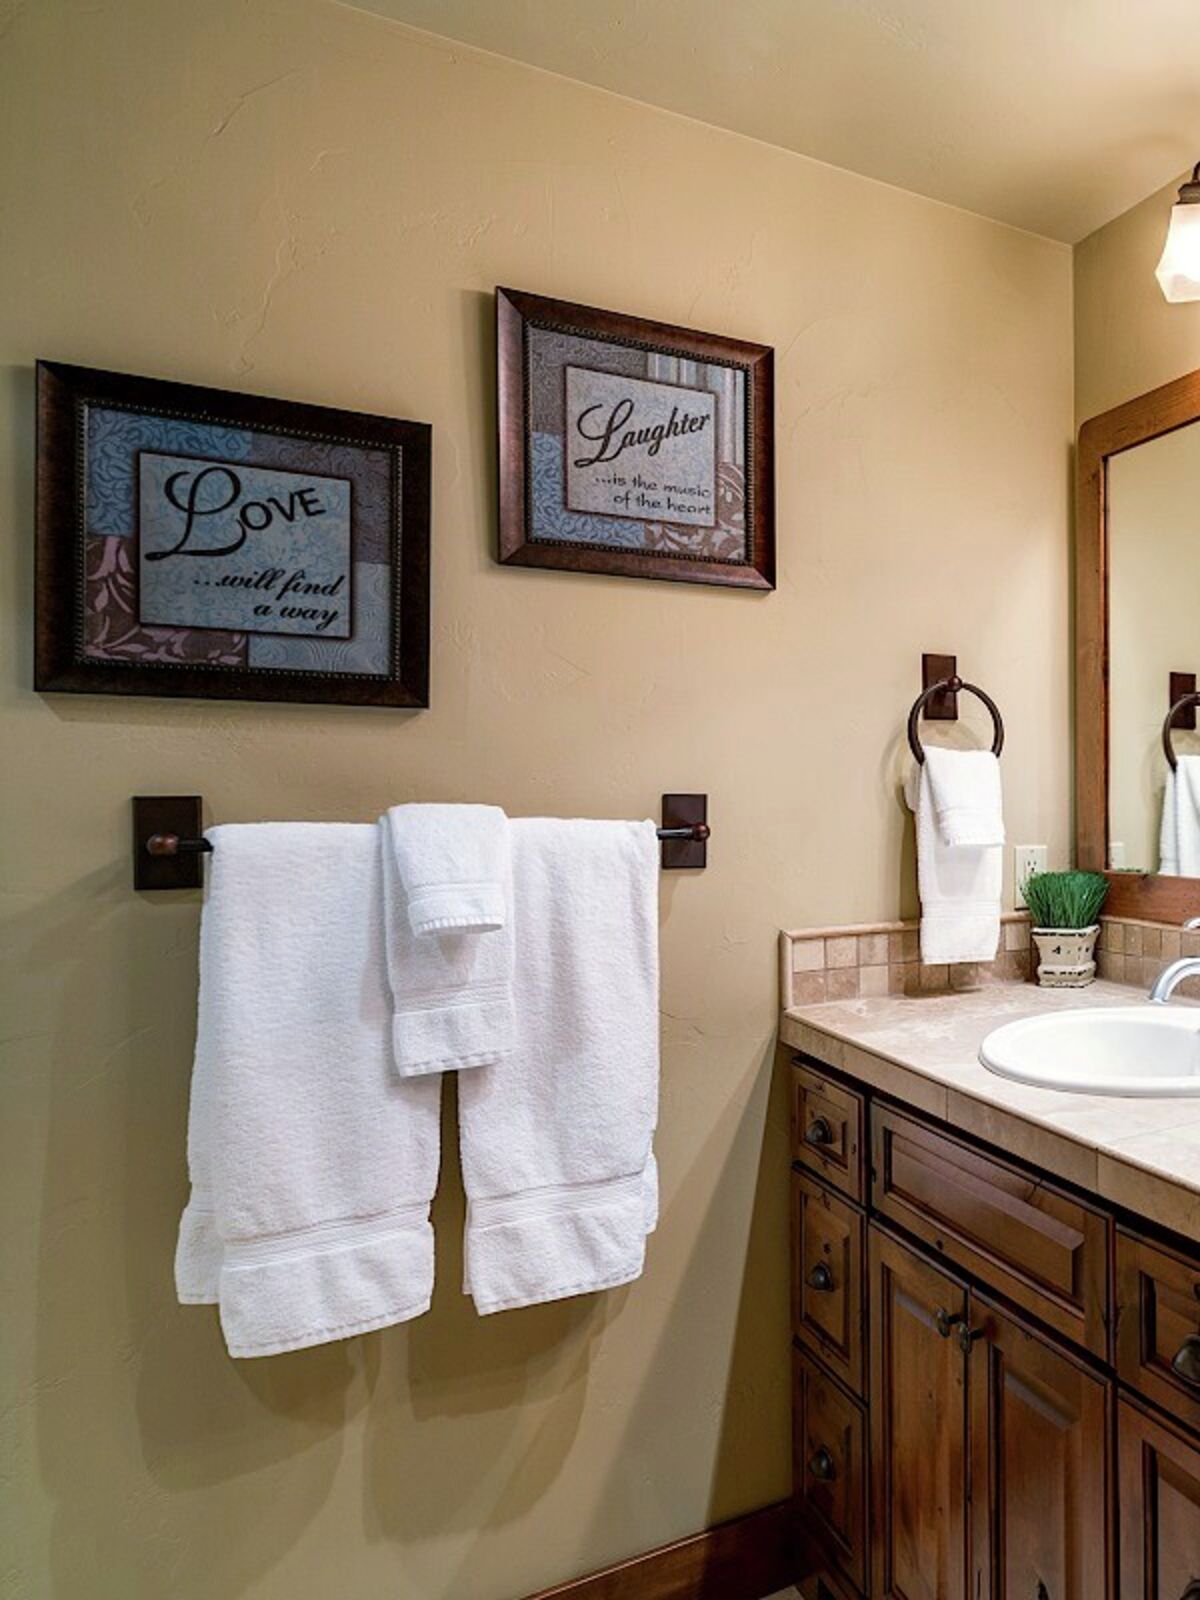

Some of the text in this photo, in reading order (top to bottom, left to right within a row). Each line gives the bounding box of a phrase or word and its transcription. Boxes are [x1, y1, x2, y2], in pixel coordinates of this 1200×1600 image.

[574, 398, 711, 468] Laughter
[632, 473, 657, 490] the
[664, 483, 711, 498] music
[613, 492, 712, 515] of the heart
[276, 568, 346, 600] find
[253, 604, 340, 629] a way
